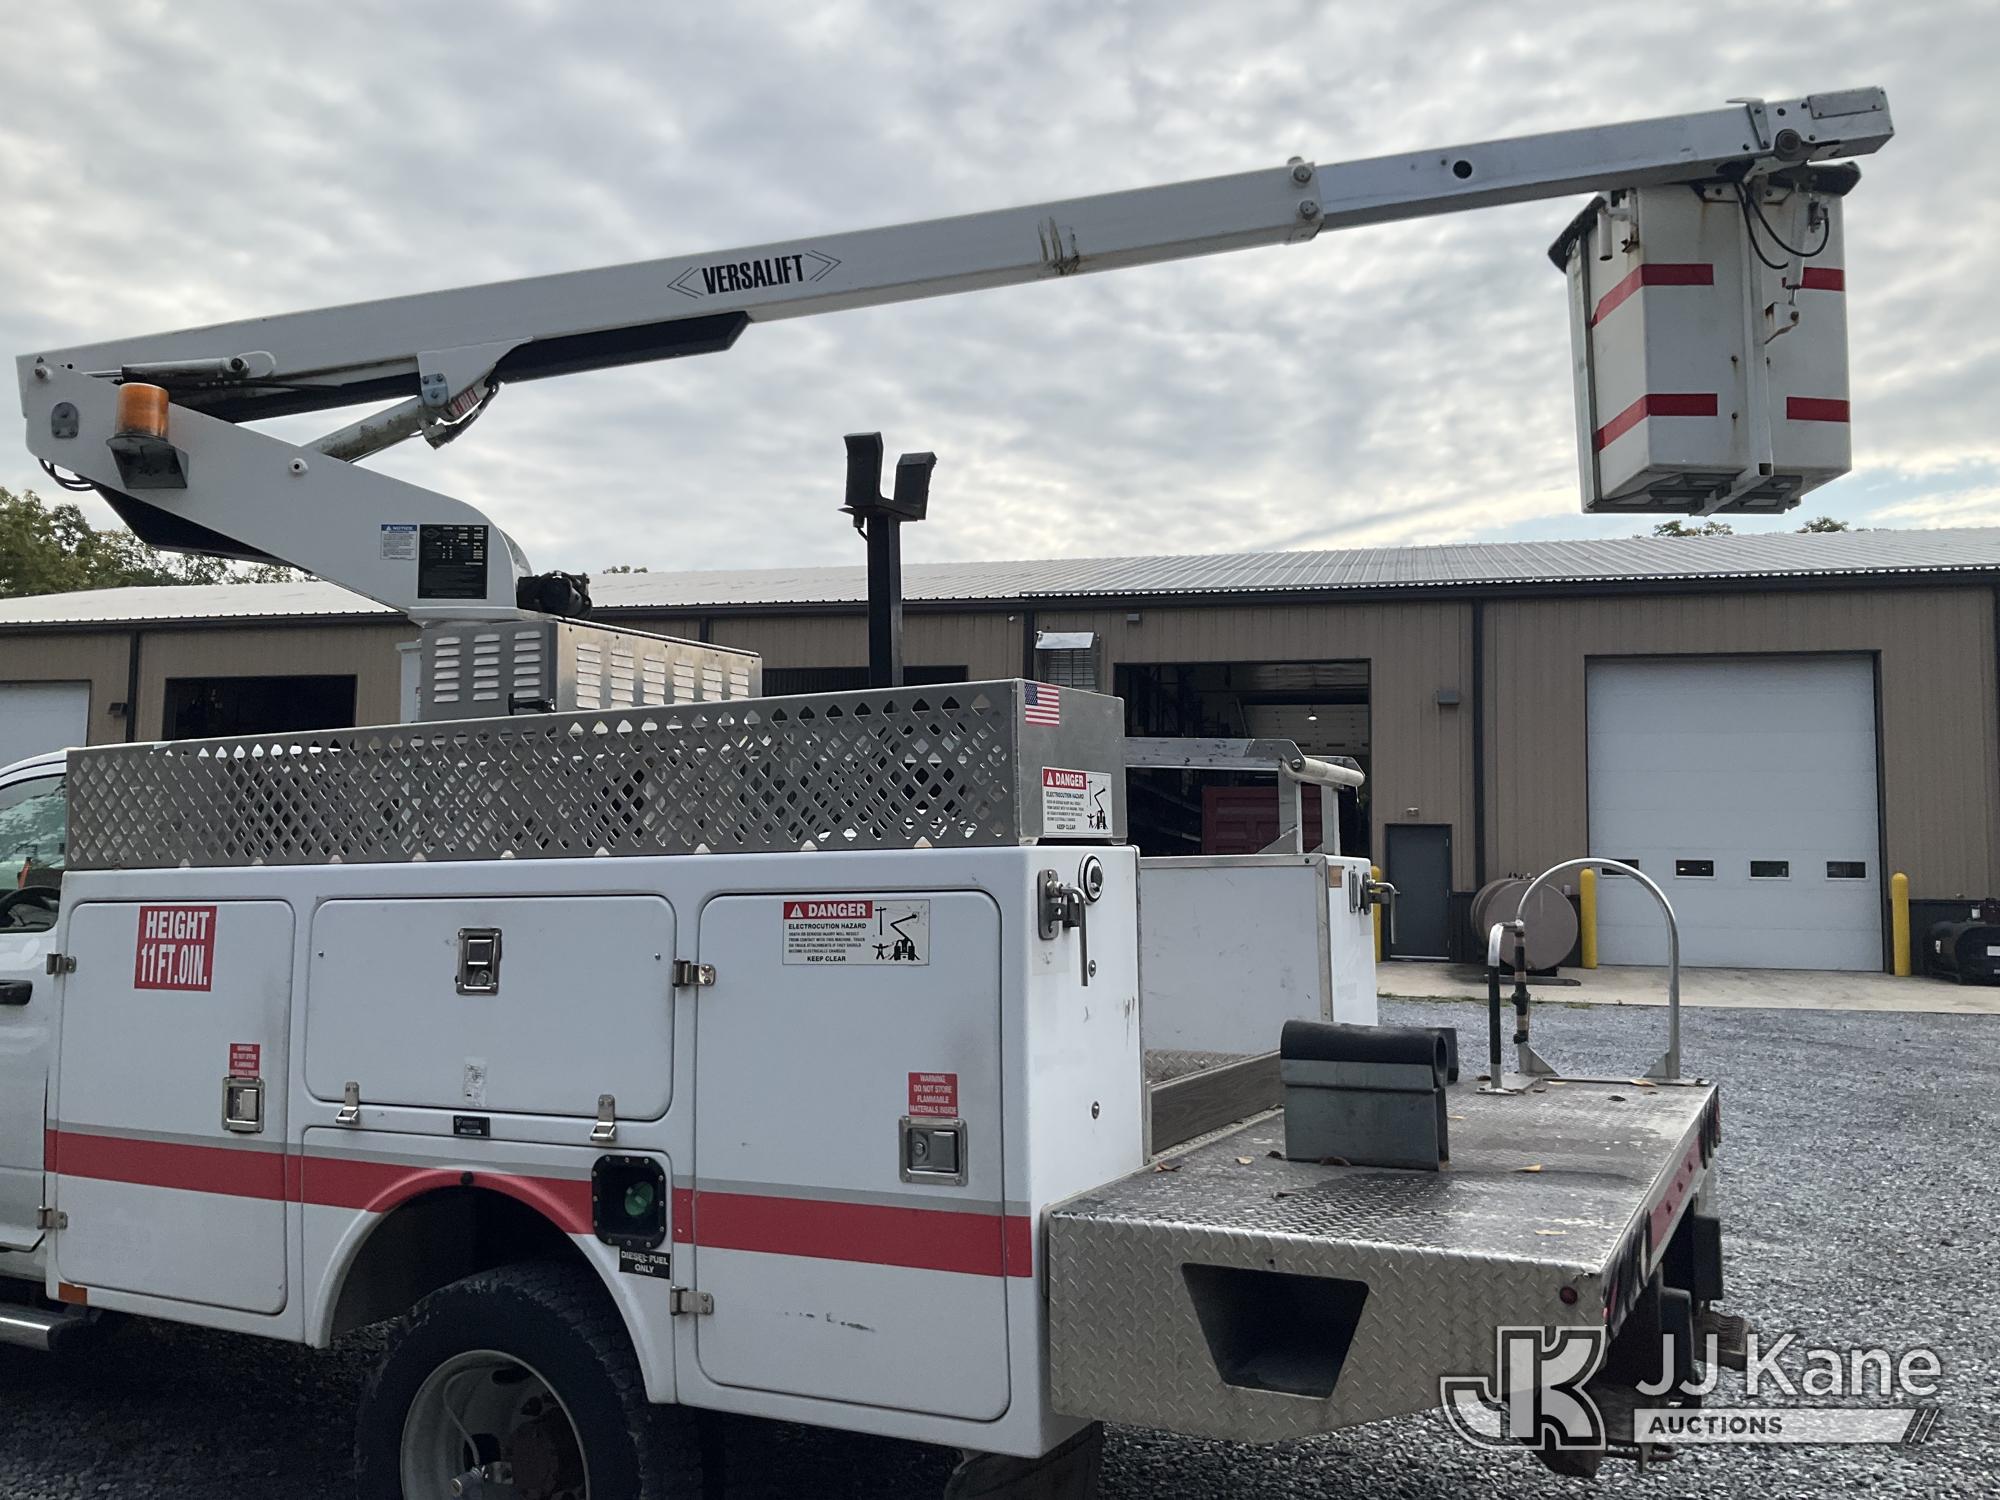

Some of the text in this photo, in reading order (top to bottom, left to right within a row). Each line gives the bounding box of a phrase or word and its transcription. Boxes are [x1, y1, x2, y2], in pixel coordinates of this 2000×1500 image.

[702, 254, 803, 295] VERSALIFT
[1055, 772, 1084, 787] DANGER
[808, 903, 867, 917] DANGER
[145, 911, 210, 939] HEIGHT
[913, 1084, 952, 1094] DO NOT STORE
[621, 1250, 669, 1265] DIESEL FUEL
[634, 1263, 655, 1273] ONLY
